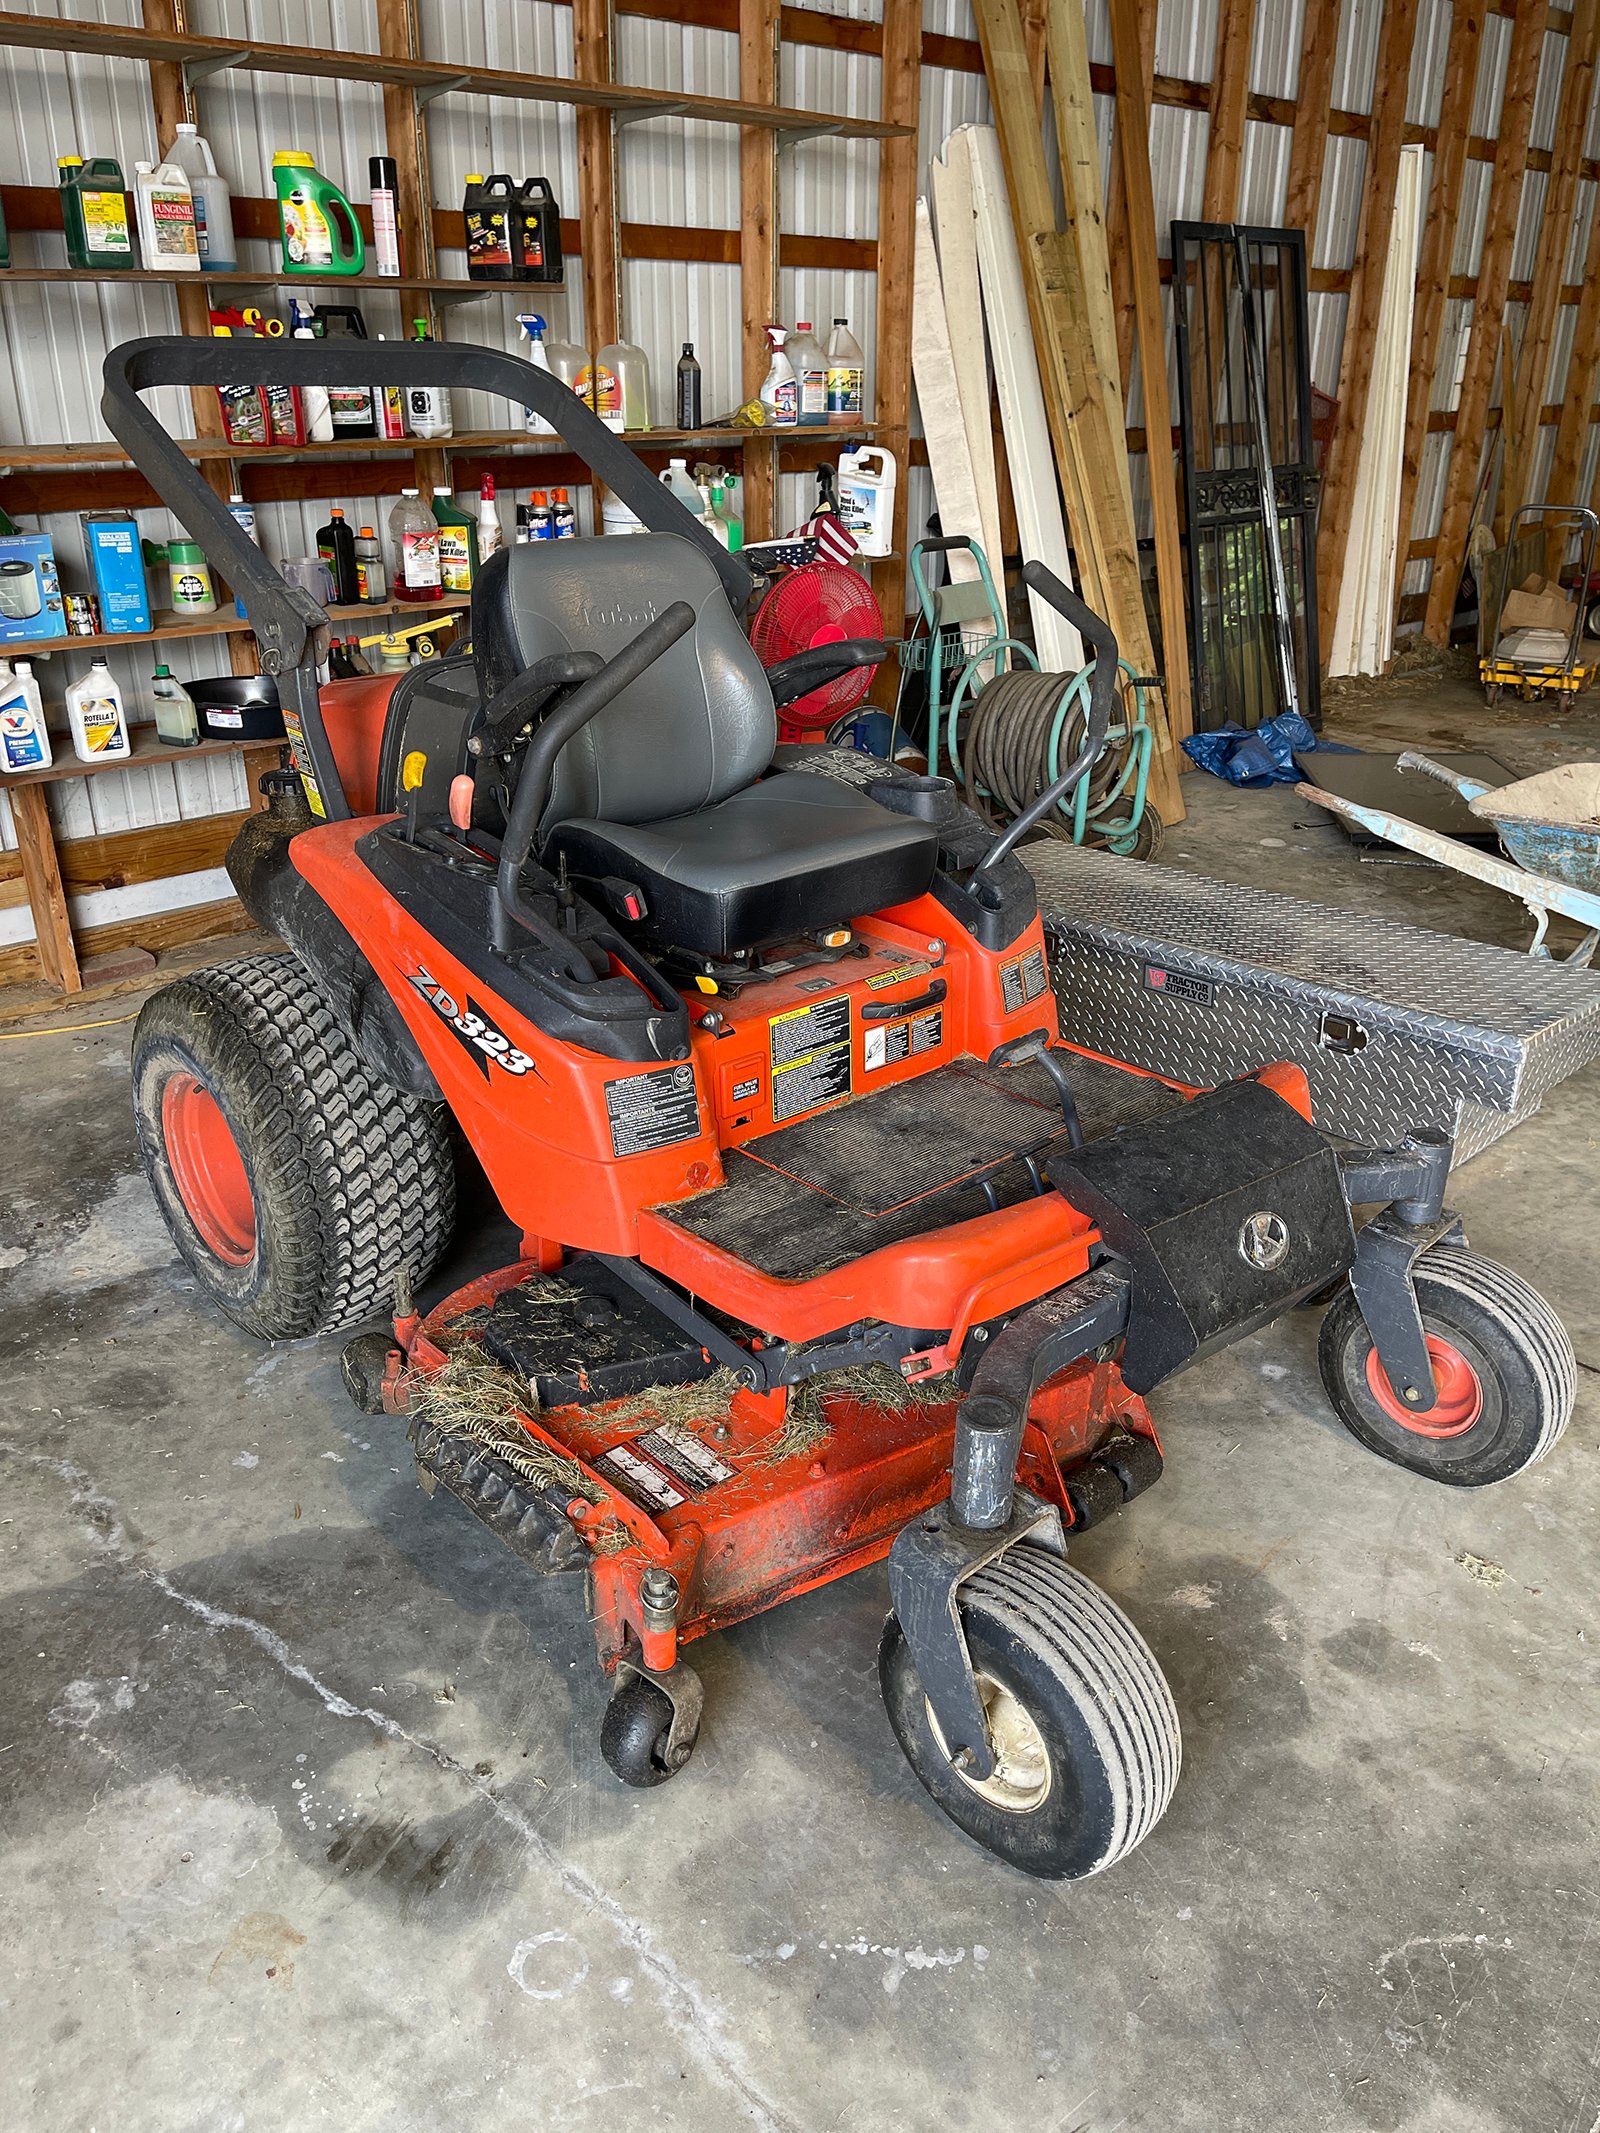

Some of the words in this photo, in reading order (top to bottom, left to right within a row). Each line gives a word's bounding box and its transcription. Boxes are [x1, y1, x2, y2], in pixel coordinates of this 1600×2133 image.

[153, 202, 193, 215] FUNGINIL
[441, 539, 457, 547] Lawn
[450, 548, 467, 557] Killer
[578, 599, 662, 628] Kubot
[84, 714, 109, 722] ROTELLA
[110, 712, 115, 720] T
[1166, 974, 1209, 993] TRACTOR
[1165, 983, 1198, 1001] SUPPLY
[407, 964, 536, 1076] ZD323
[782, 1011, 801, 1020] CAUTION
[615, 1074, 648, 1085] IMPORTANT
[620, 1106, 655, 1119] IMPORTANTE
[646, 1463, 670, 1482] DANGER
